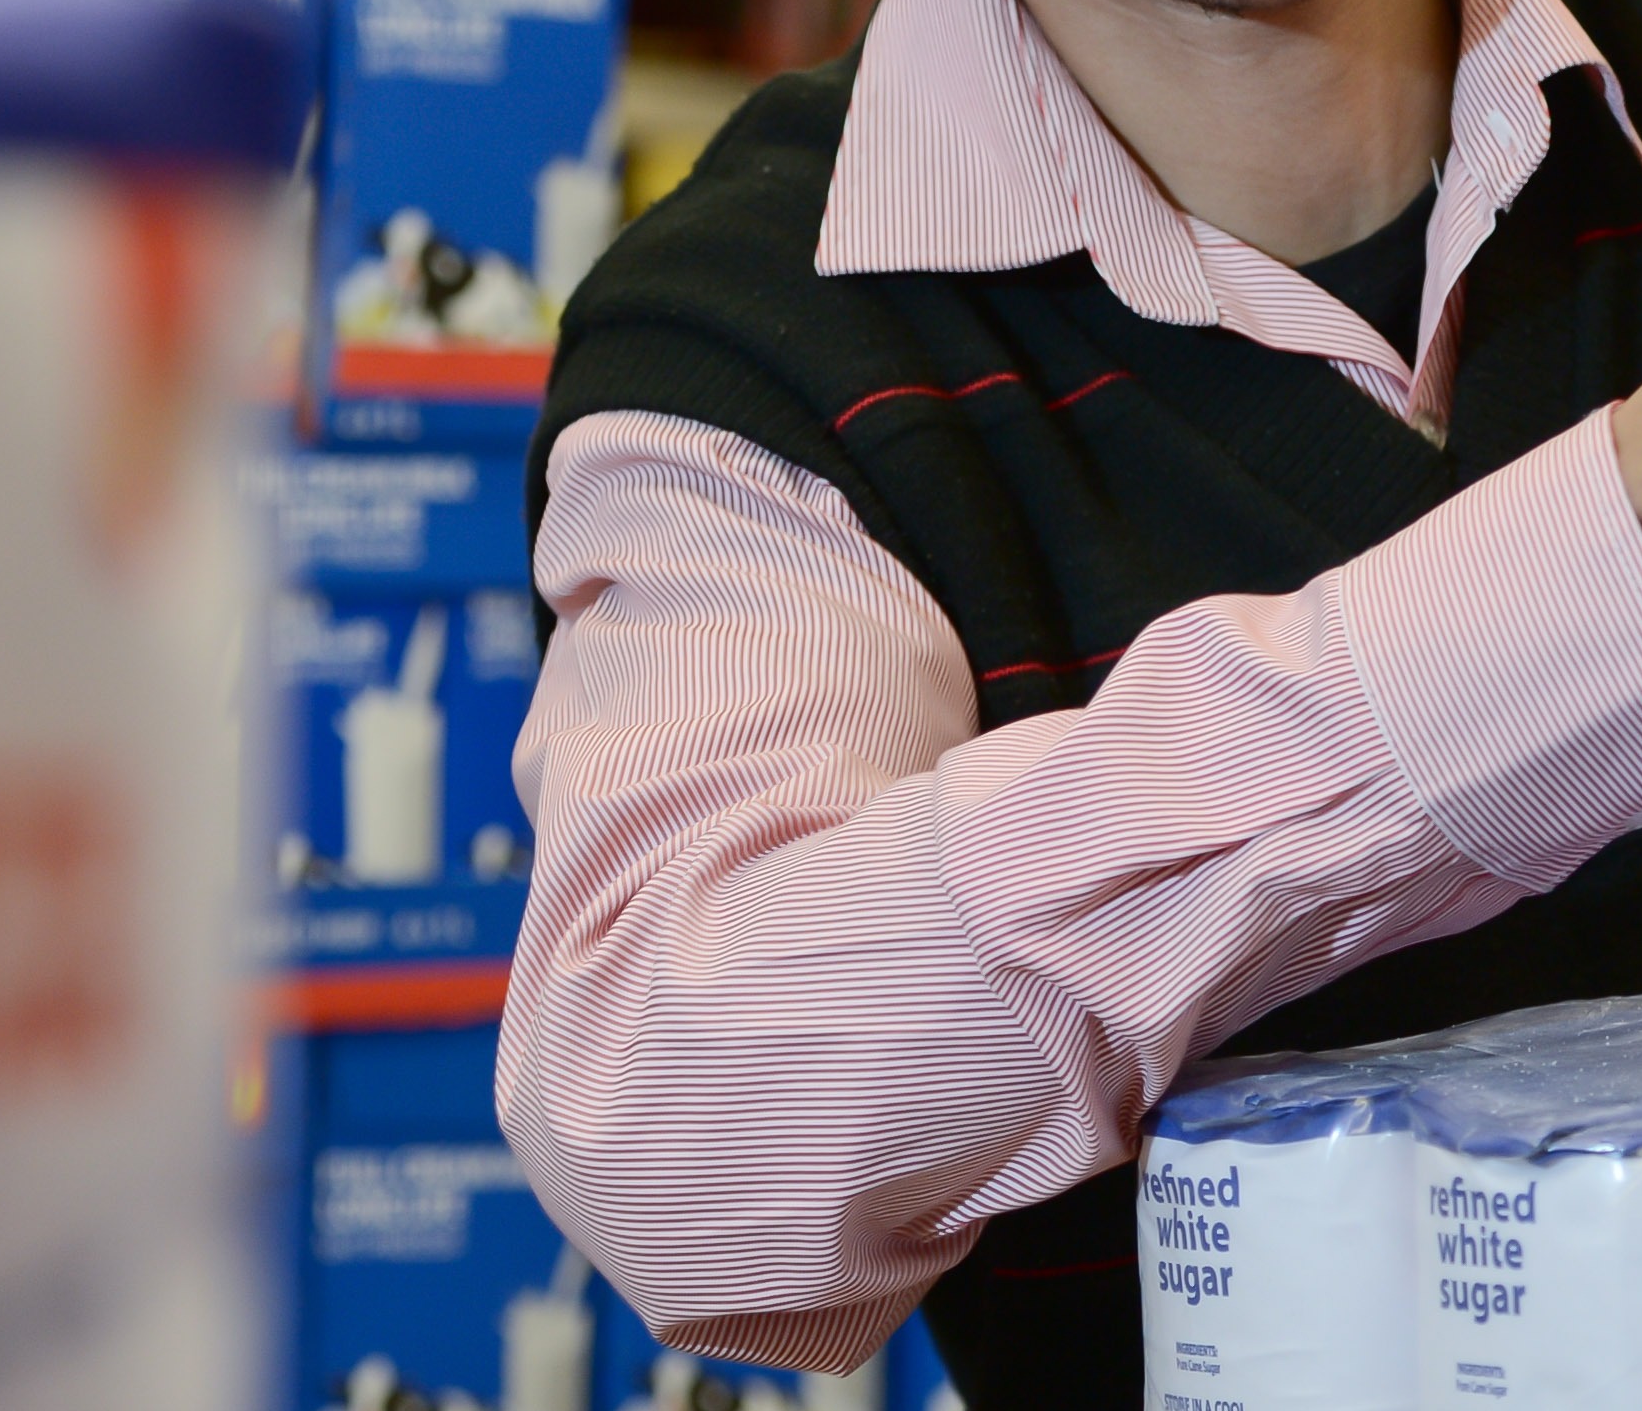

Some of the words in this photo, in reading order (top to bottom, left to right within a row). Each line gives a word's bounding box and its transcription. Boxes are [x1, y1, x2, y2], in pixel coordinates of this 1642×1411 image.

[1143, 1163, 1240, 1208] refined
[1430, 1177, 1537, 1224] refined
[1157, 1208, 1230, 1253] white
[1438, 1224, 1524, 1269] white
[1158, 1259, 1233, 1305] sugar
[1440, 1276, 1526, 1324] sugar
